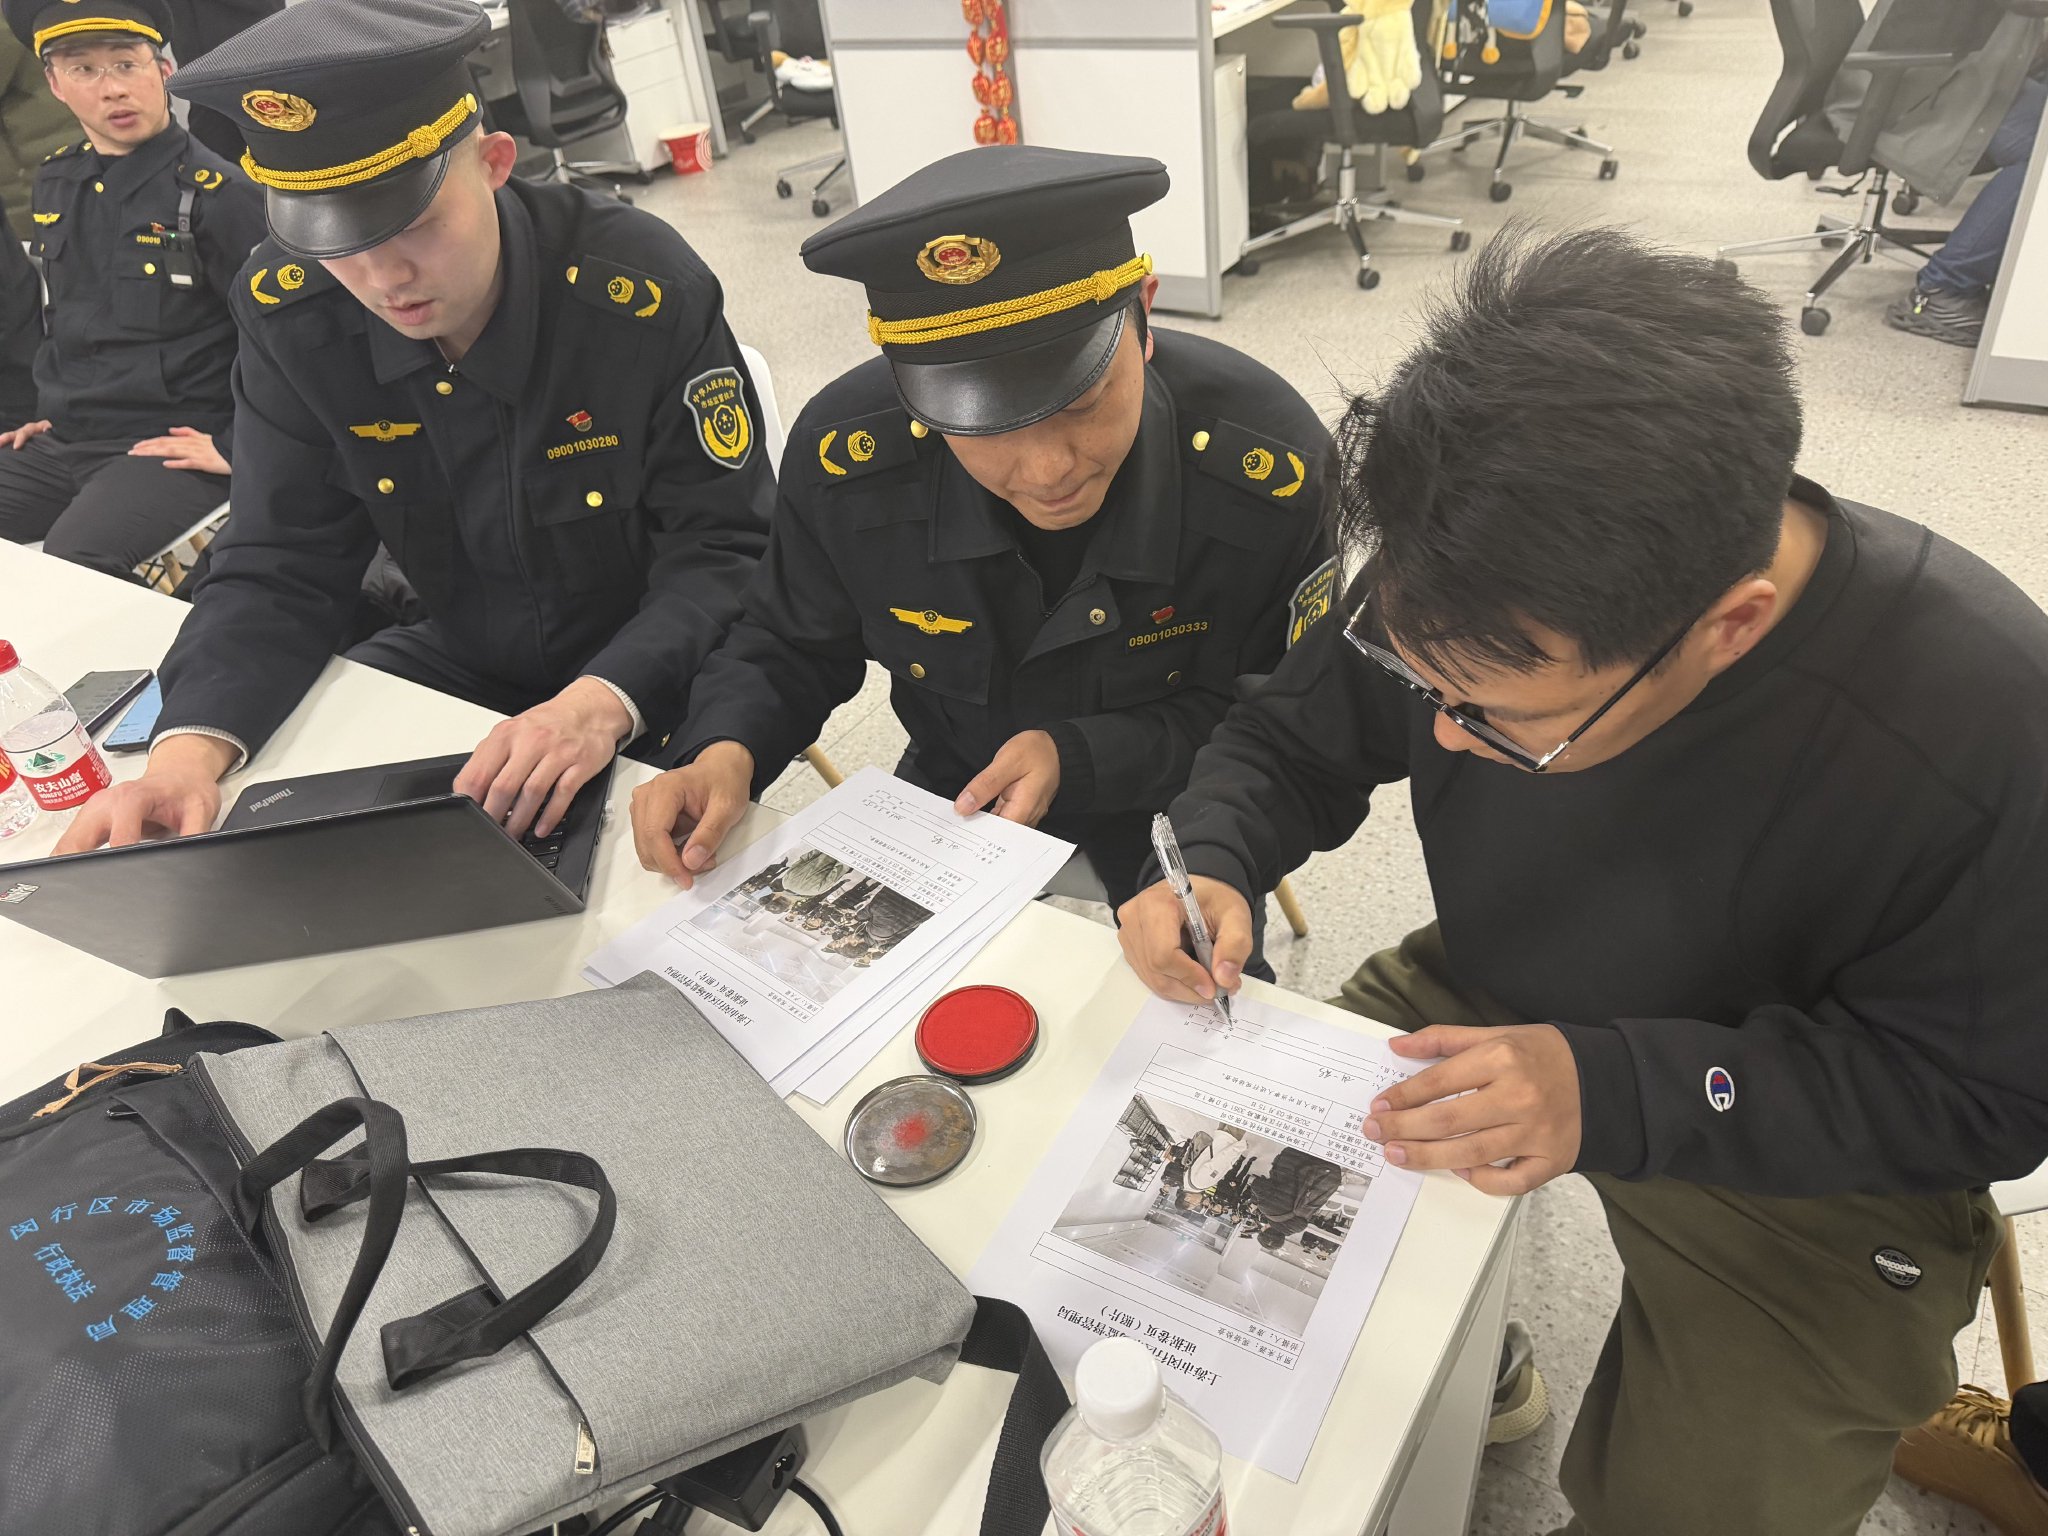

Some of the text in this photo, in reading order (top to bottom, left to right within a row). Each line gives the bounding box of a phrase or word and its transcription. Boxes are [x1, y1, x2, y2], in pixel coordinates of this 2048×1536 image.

[547, 435, 619, 460] 09001030280
[1128, 621, 1208, 647] 09001030333
[33, 769, 84, 793] 农夫山泉
[64, 781, 87, 795] SPRING
[249, 788, 295, 812] ThinkPad
[9, 1195, 197, 1342] 闵行区市场监督管理局
[33, 1242, 97, 1303] 行政执法
[1055, 1303, 1223, 1388] 上海市闵行监督管理局
